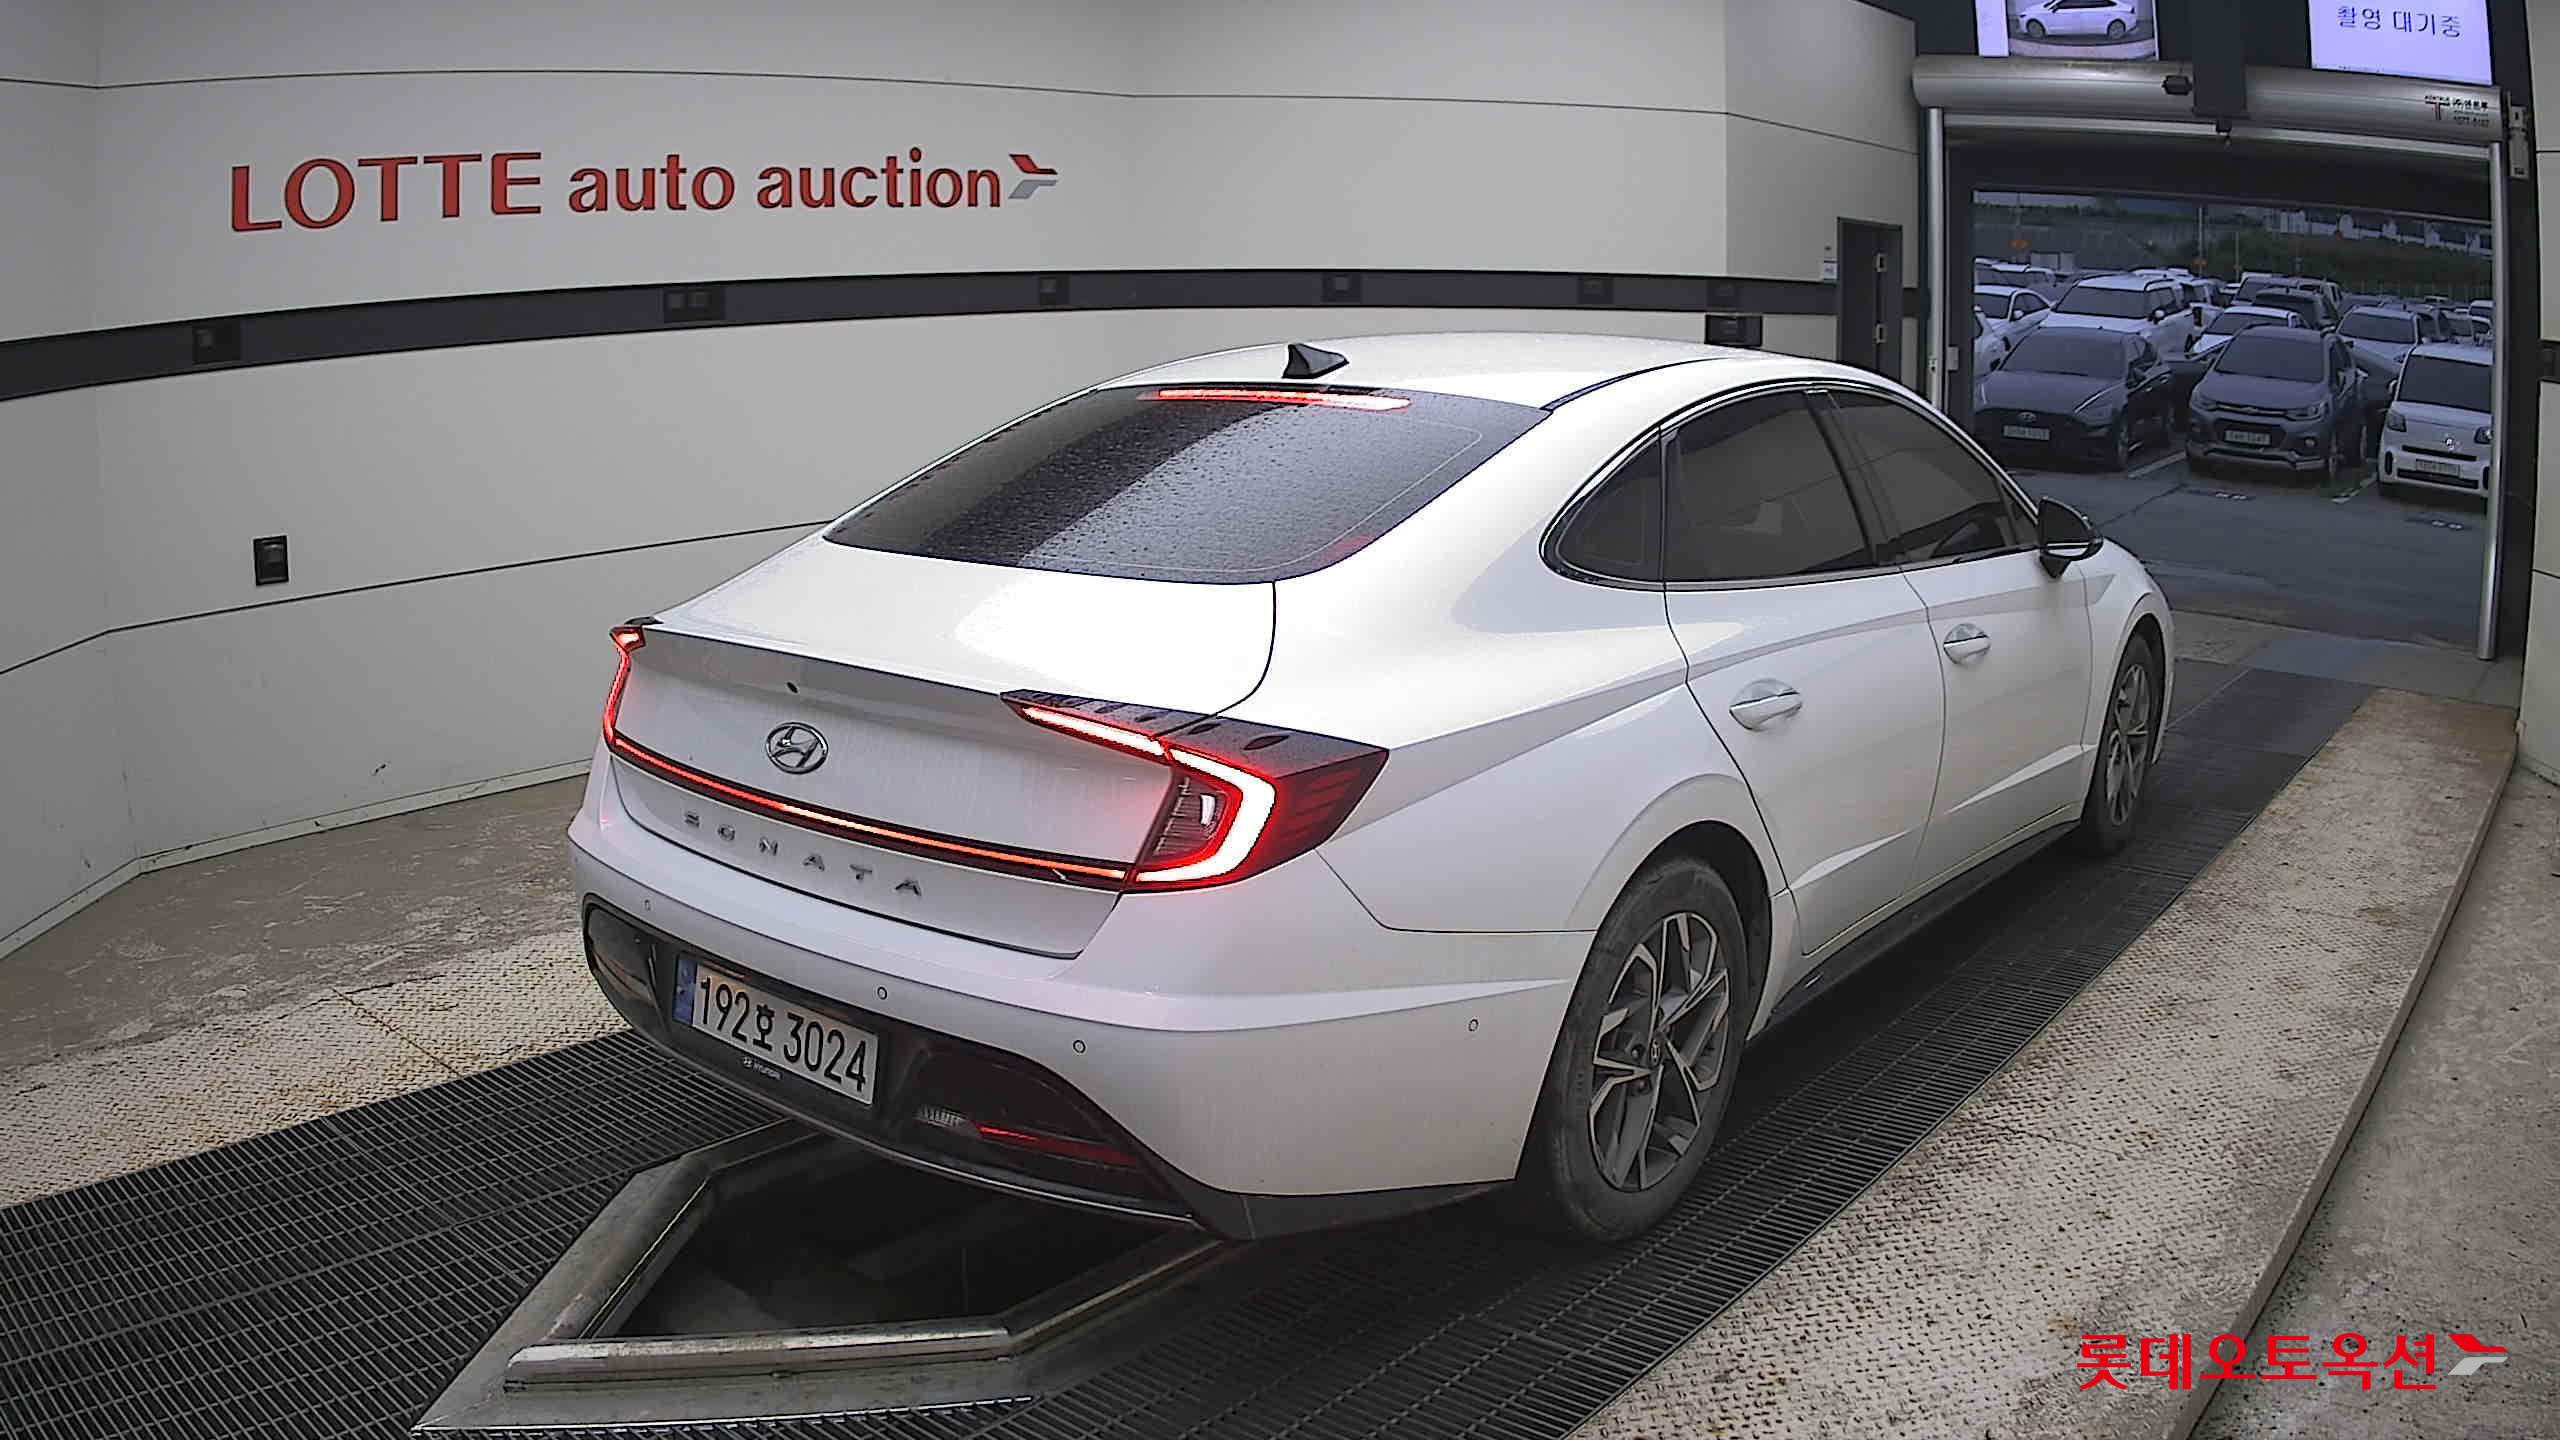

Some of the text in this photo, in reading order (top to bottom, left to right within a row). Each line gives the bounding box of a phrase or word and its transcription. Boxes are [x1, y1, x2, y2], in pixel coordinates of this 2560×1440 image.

[2337, 5, 2462, 39] 촬영 대기중
[231, 146, 1001, 233] LOTTE auto auction
[684, 811, 922, 897] SONATA
[700, 975, 867, 1093] 192호 3024
